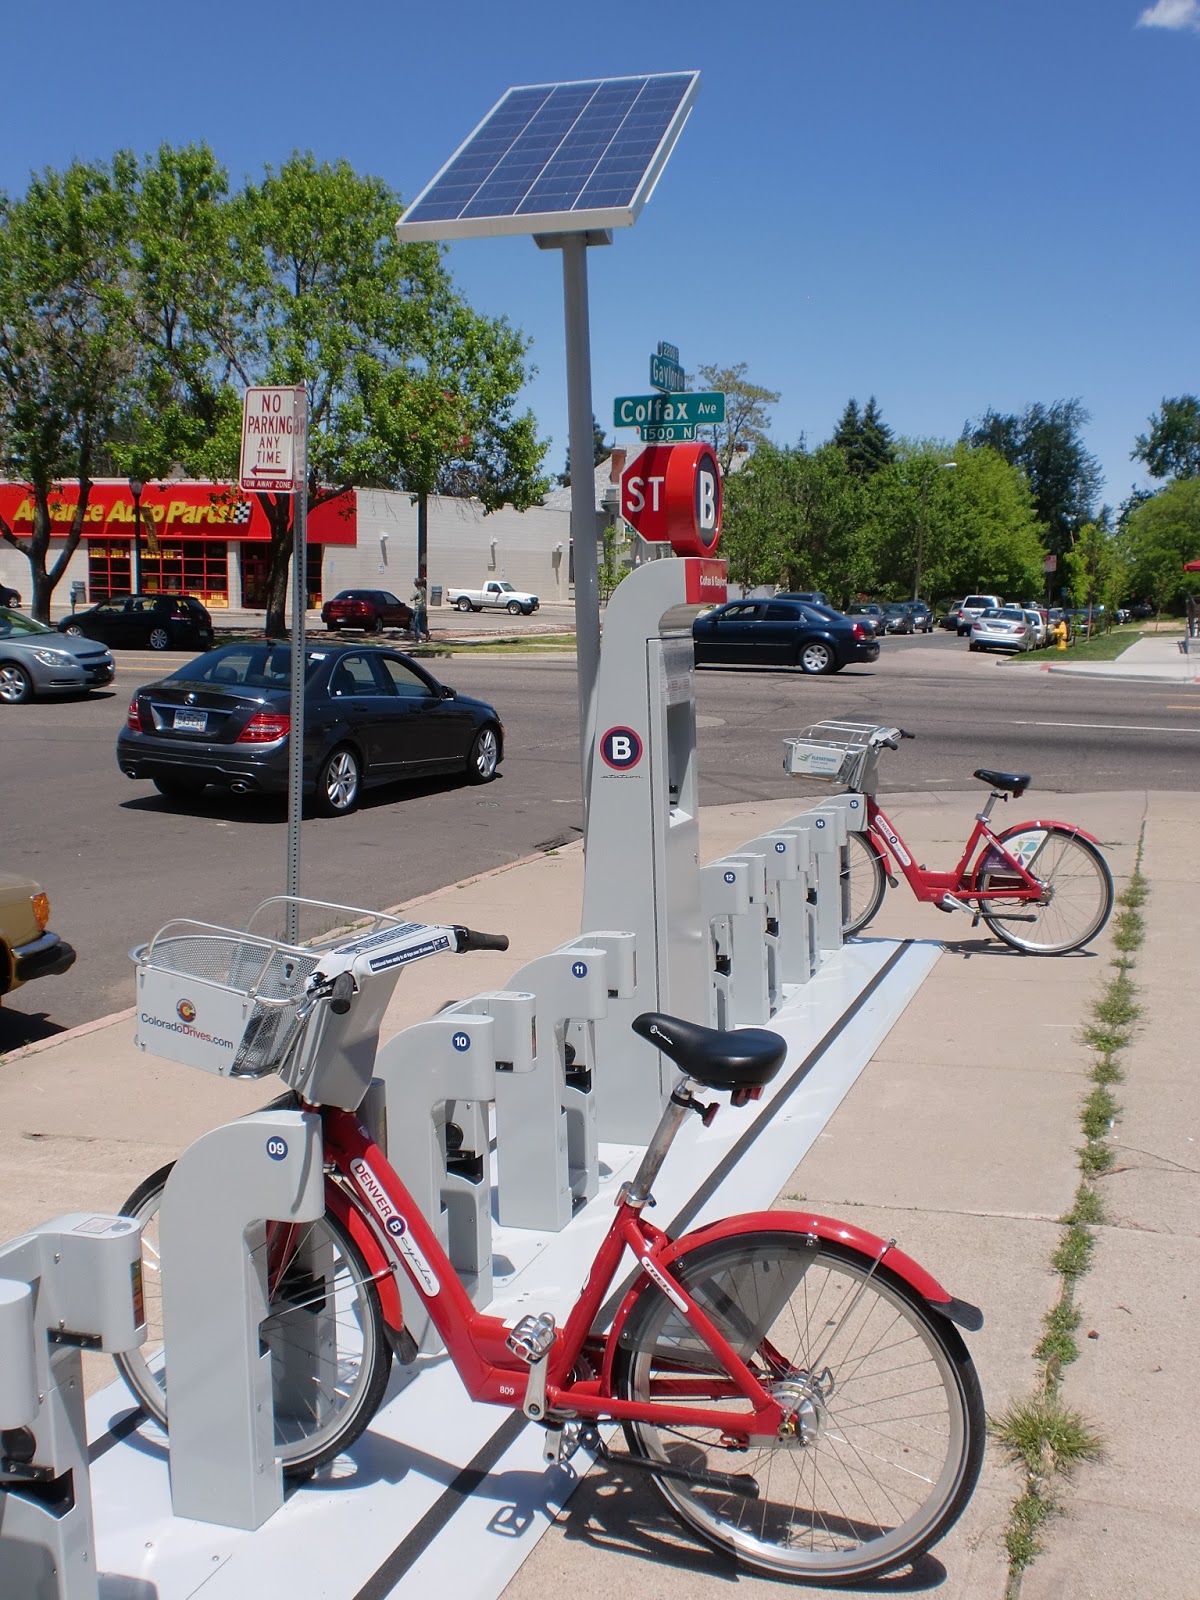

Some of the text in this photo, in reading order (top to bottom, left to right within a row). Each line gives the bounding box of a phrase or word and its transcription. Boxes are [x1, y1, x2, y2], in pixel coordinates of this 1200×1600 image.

[653, 358, 680, 391] Gaylord
[262, 394, 282, 413] NO
[620, 399, 717, 423] Colfax Ave
[248, 415, 293, 435] PARKING
[643, 426, 692, 440] 1500 N
[258, 436, 280, 449] ANY
[256, 450, 282, 464] TIME
[243, 480, 255, 488] TOW
[256, 480, 273, 488] AWAY
[275, 480, 292, 489] ZONE
[626, 476, 665, 512] ST
[700, 470, 715, 530] B
[700, 575, 711, 586] Colfax
[612, 736, 632, 760] B
[574, 966, 584, 974] 11
[141, 1013, 234, 1050] ColoradoDrives.com
[454, 1036, 466, 1046] 10
[268, 1142, 284, 1155] 09
[354, 1163, 392, 1217] DENVER
[389, 1220, 402, 1232] B
[644, 1260, 672, 1293] TREK
[500, 1385, 515, 1396] 809
